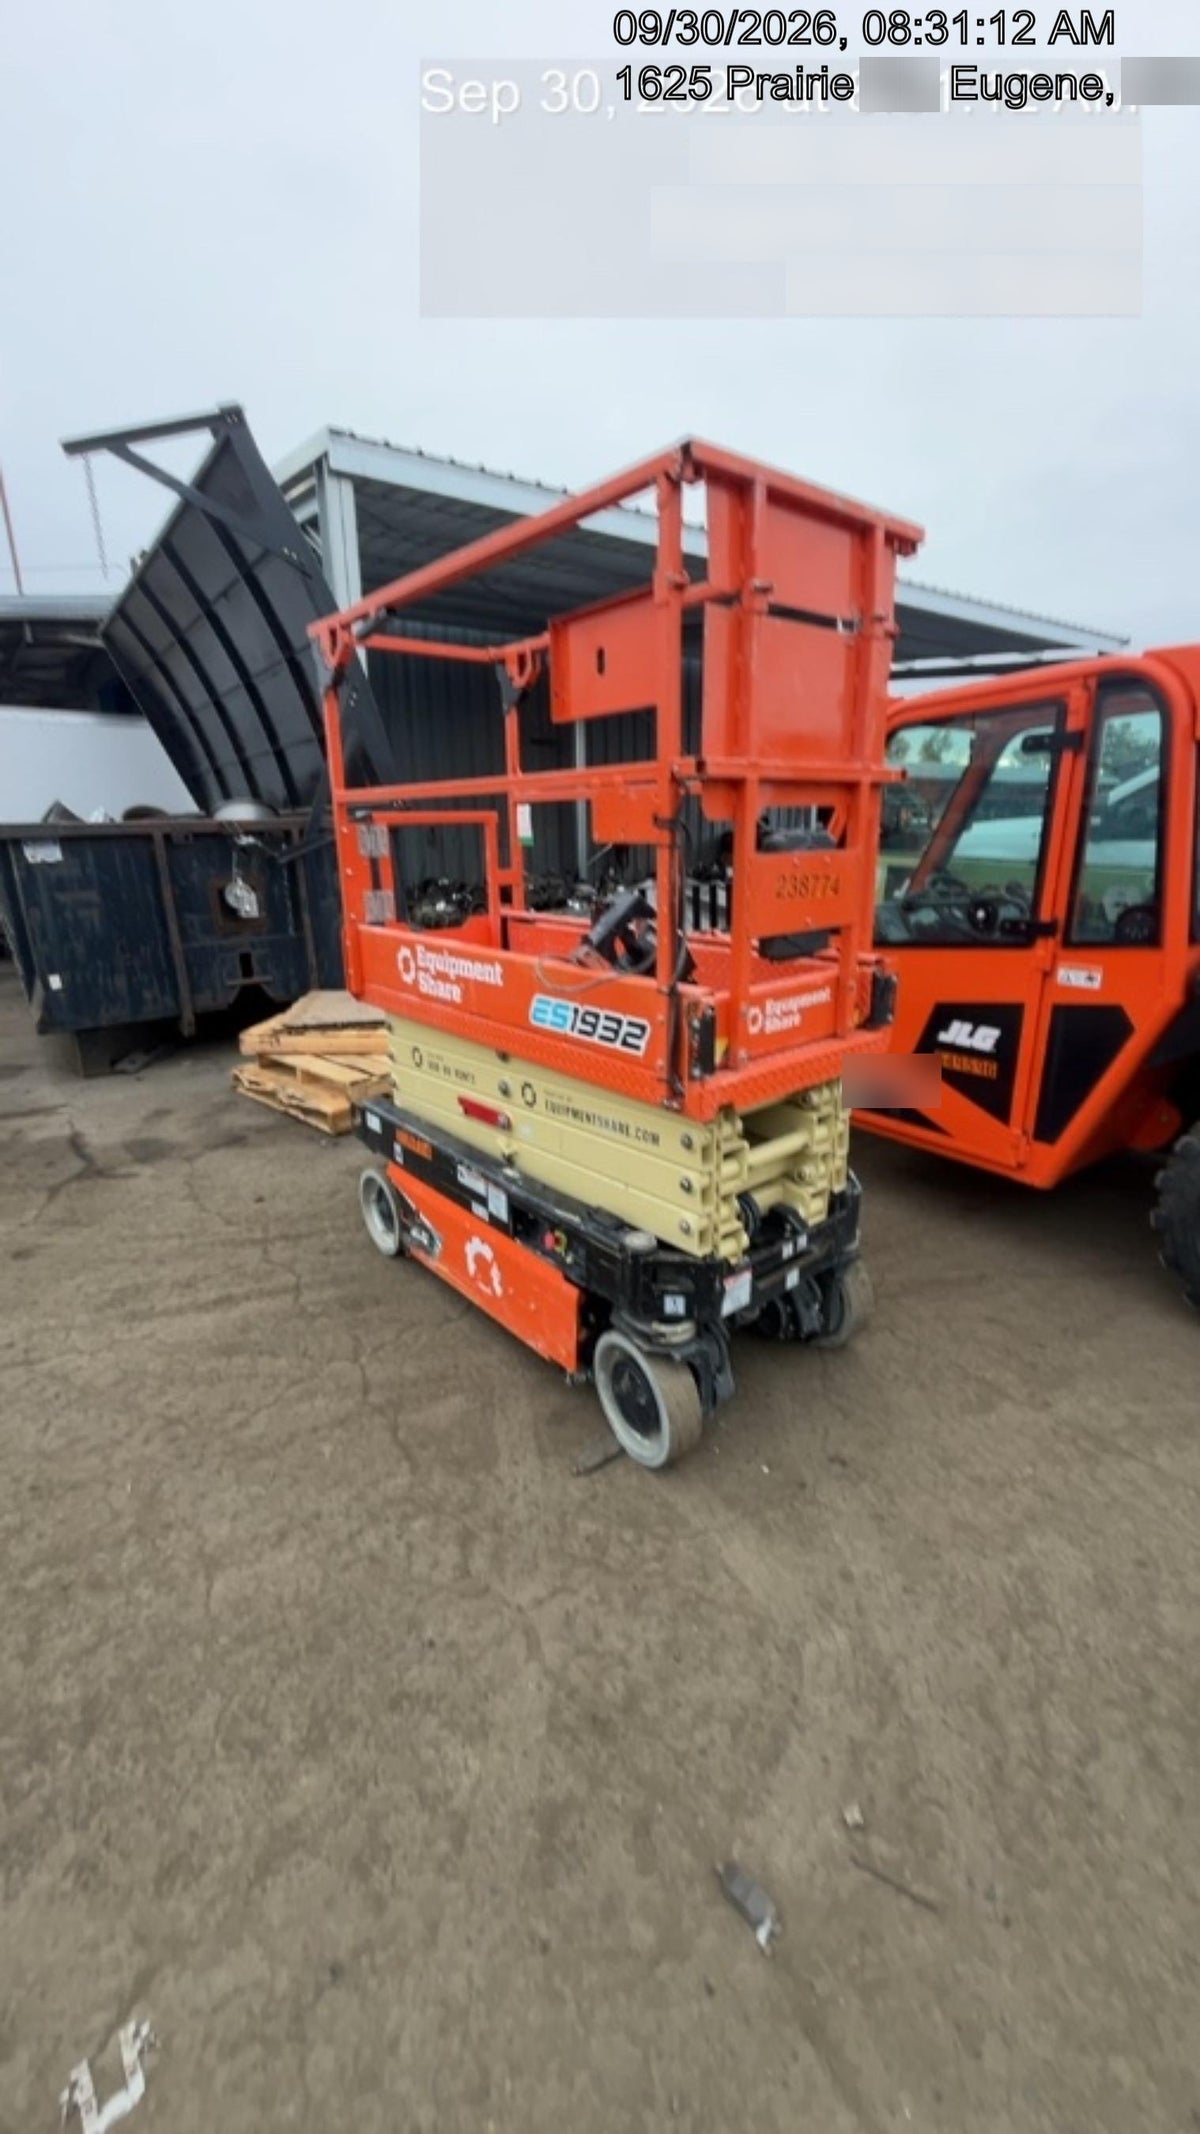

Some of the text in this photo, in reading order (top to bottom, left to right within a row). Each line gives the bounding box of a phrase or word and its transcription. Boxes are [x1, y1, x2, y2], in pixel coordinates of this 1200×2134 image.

[776, 873, 841, 899] 238774
[416, 944, 503, 987] Equipment
[418, 969, 462, 1004] Share
[532, 996, 648, 1052] ES1932
[937, 1019, 1001, 1053] JLG
